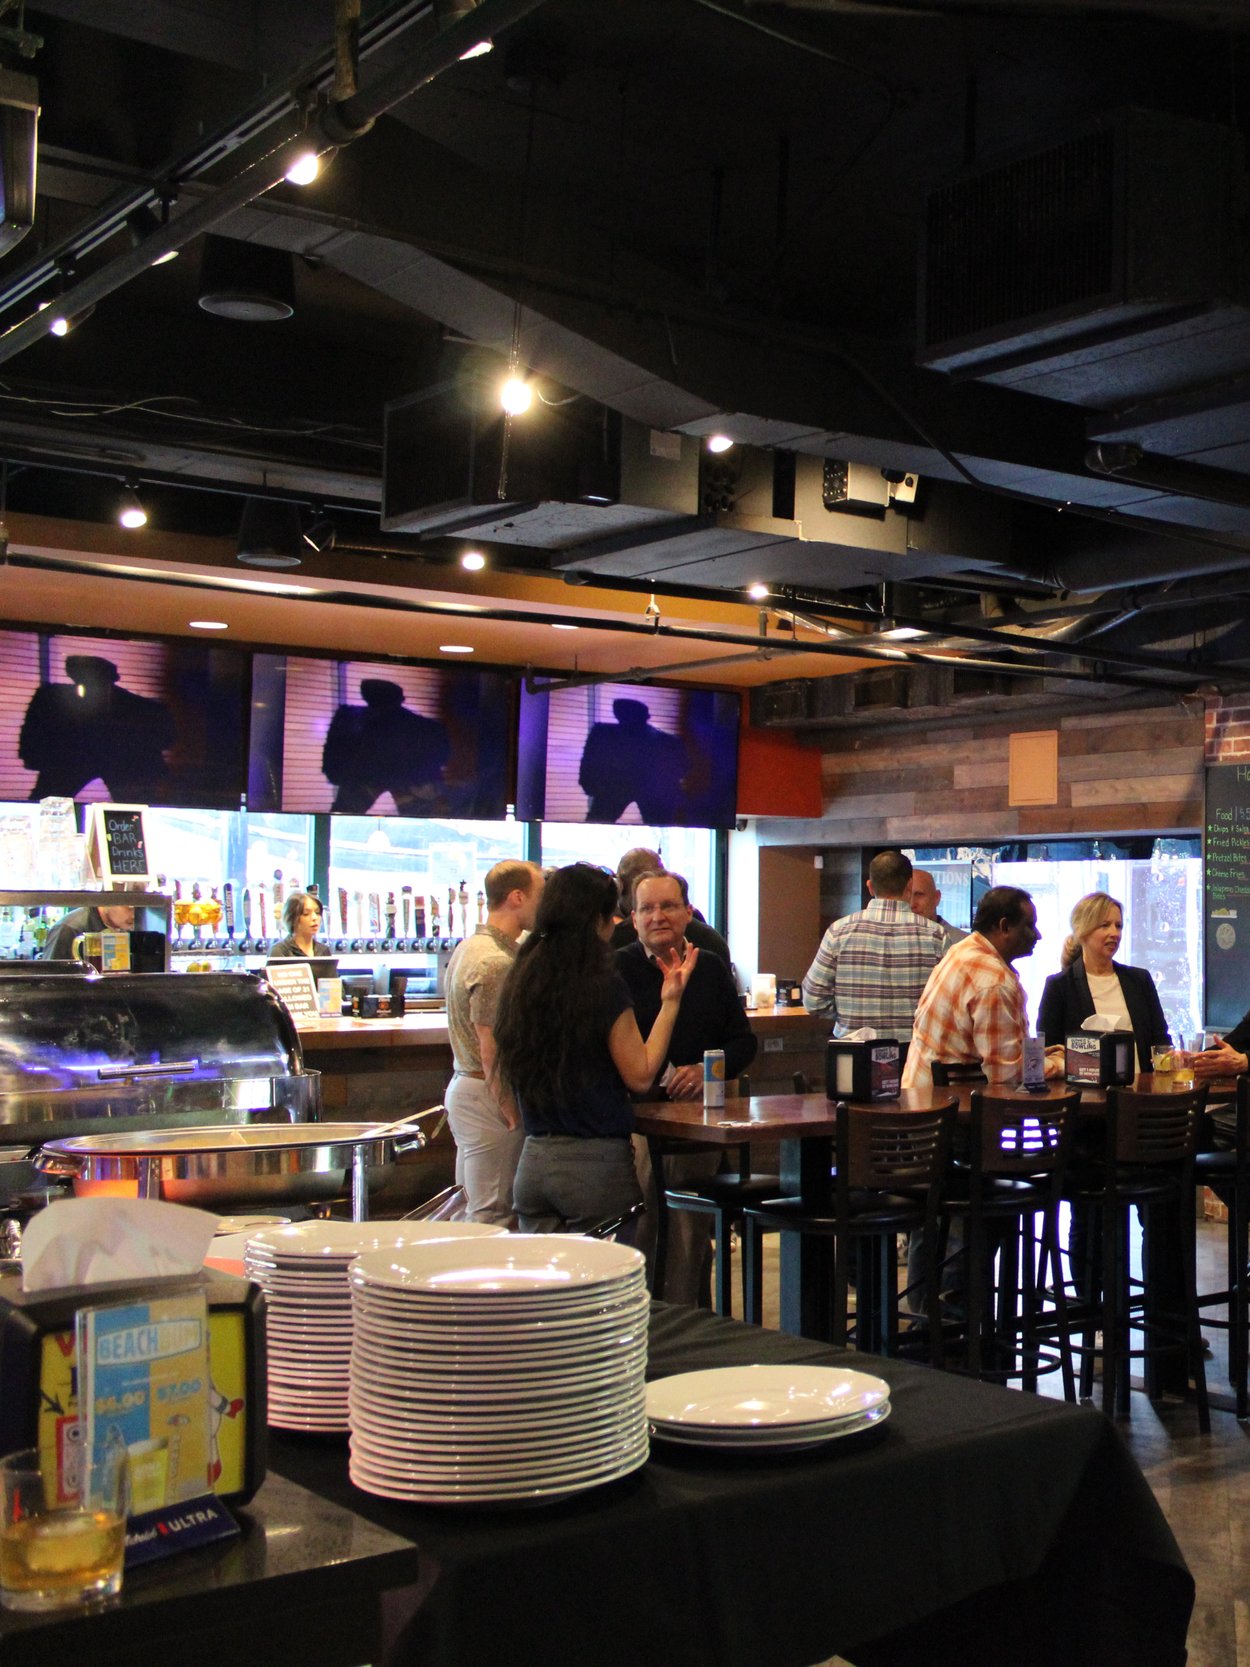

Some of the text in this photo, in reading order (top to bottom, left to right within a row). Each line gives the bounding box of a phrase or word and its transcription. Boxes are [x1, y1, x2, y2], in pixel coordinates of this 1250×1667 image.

[1215, 807, 1233, 820] Food
[108, 819, 134, 831] Order
[112, 832, 137, 845] BAR
[1212, 837, 1250, 847] Fried Pickles
[112, 846, 144, 858] Drinks
[1212, 852, 1248, 862] Pretzel Bites
[112, 860, 146, 873] HERE
[932, 871, 969, 886] TIONS
[98, 1326, 159, 1360] BEACH
[167, 1508, 219, 1532] ULTRA
